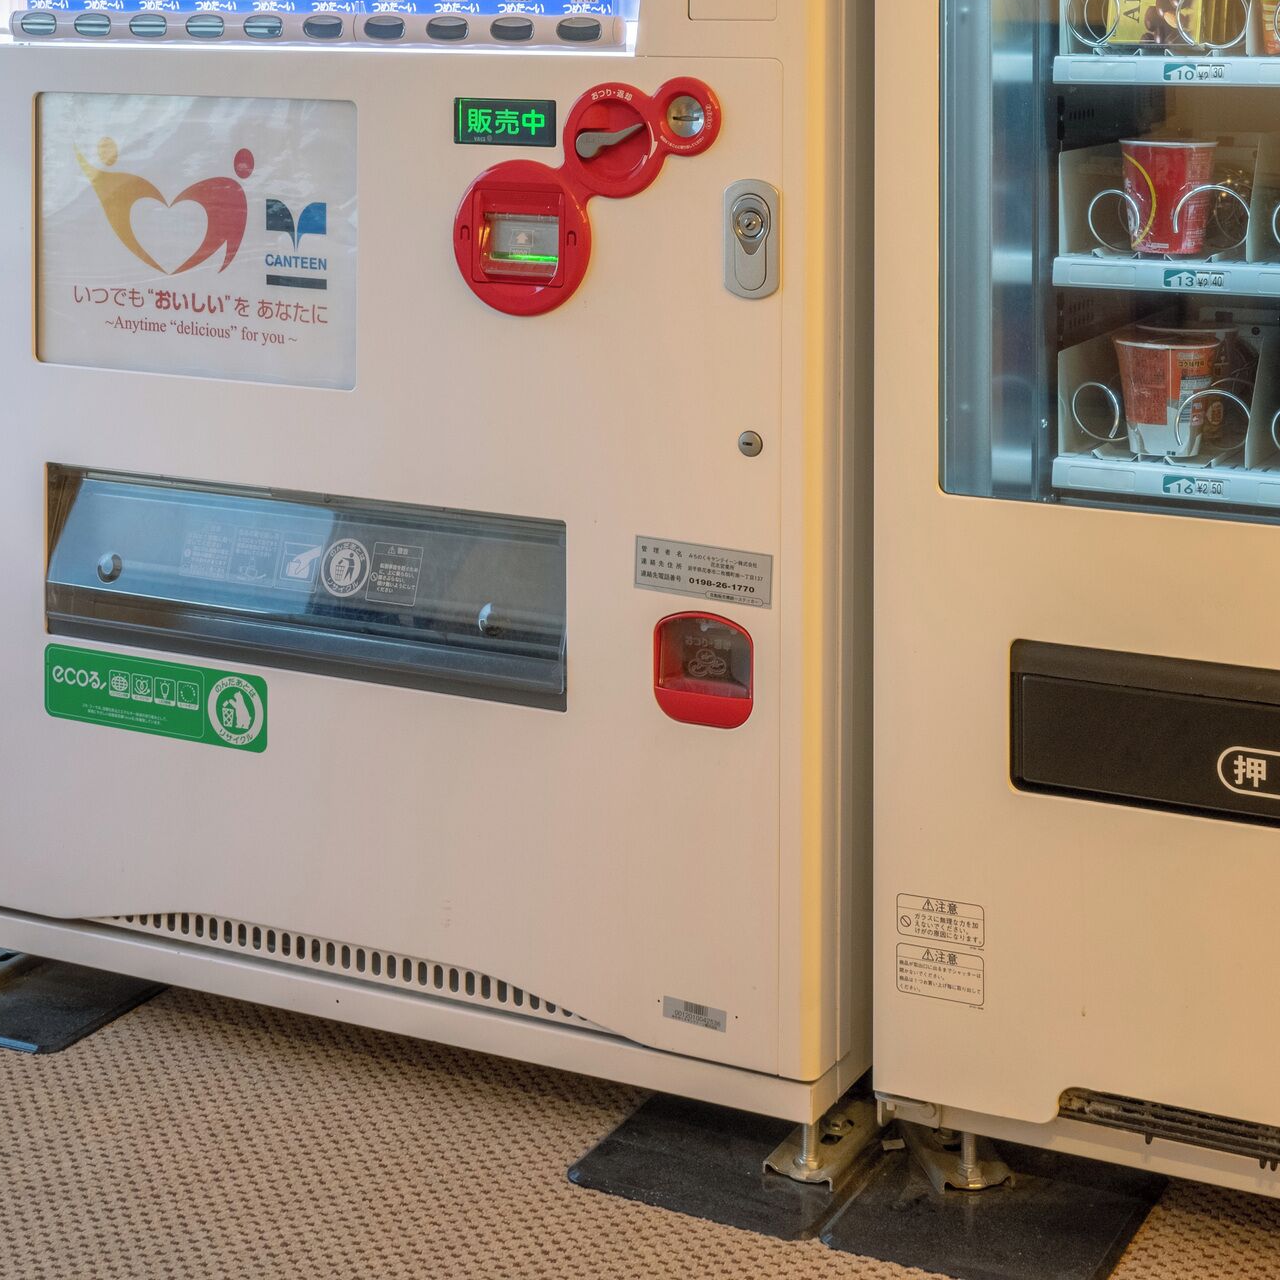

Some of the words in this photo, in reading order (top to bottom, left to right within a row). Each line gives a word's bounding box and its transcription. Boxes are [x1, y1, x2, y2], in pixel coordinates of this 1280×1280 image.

[1176, 68, 1194, 80] 10
[468, 108, 546, 136] 販売中
[265, 254, 328, 271] CANTEEN
[1176, 275, 1195, 287] 13
[257, 297, 329, 324] あなたに
[241, 326, 259, 343] for
[262, 330, 286, 346] you
[1174, 482, 1193, 494] 16
[686, 577, 753, 594] 0198-26-1770
[214, 677, 257, 700] のんだあとは
[219, 728, 255, 745] リサイクル
[935, 901, 958, 915] 注意
[934, 951, 958, 966] 注意
